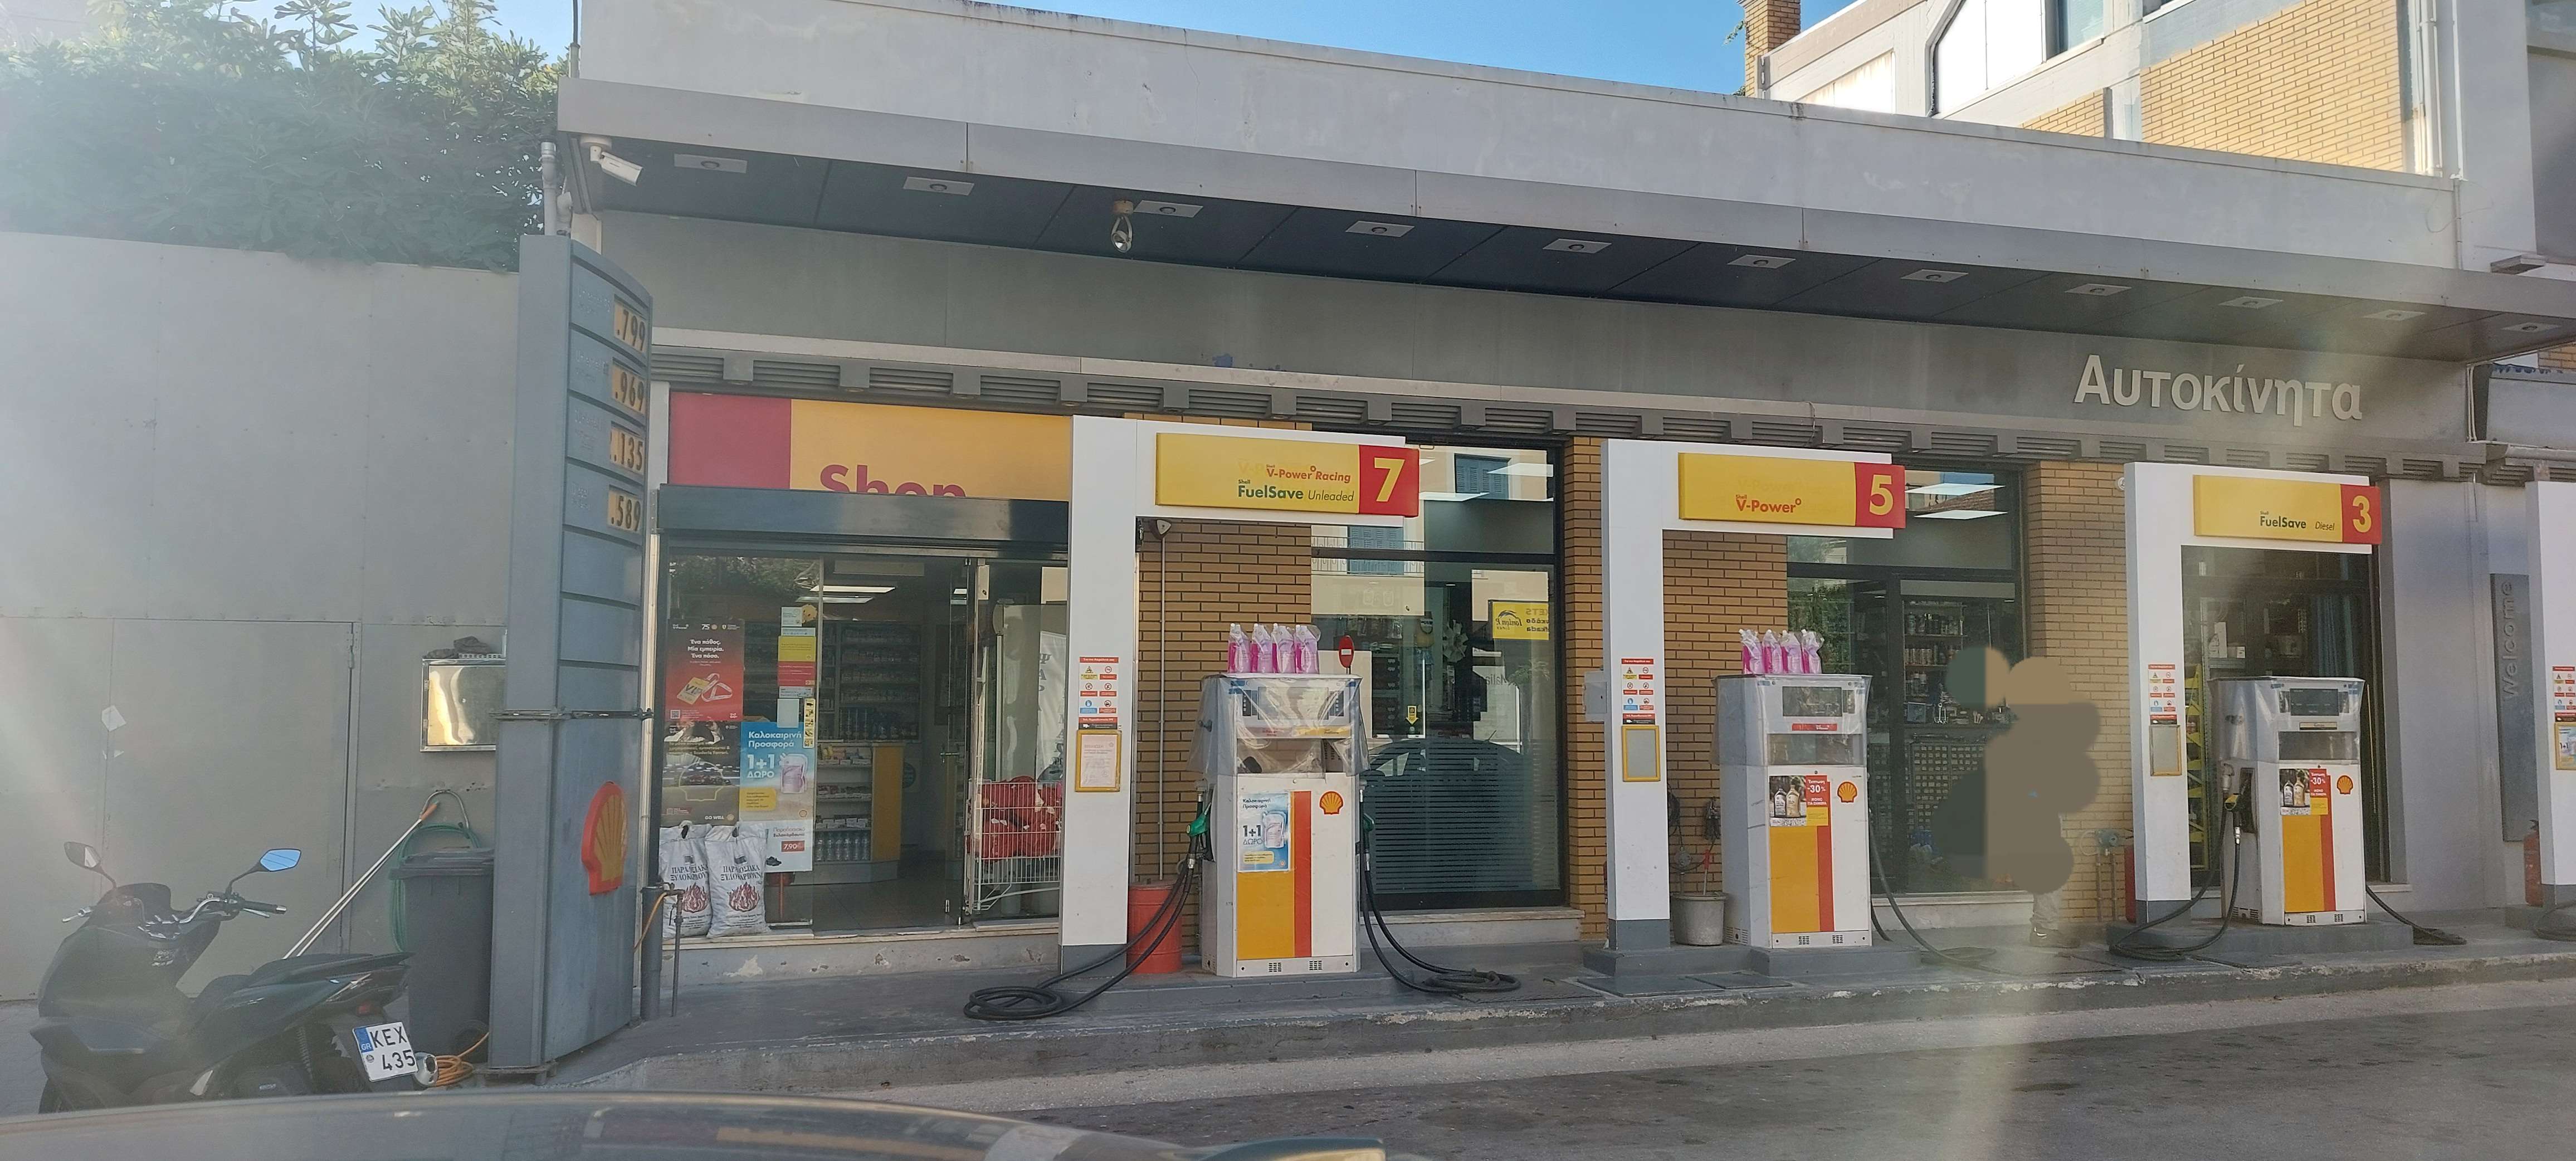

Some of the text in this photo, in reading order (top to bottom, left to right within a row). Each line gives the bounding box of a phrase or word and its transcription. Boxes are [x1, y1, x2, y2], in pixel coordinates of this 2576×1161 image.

[617, 309, 646, 352] .799
[614, 371, 645, 412] .969
[2074, 354, 2363, 427] Αυτοκίνητα
[610, 432, 643, 471] .135
[1266, 468, 1351, 484] V-Power Racing
[1374, 457, 1406, 502] 7
[1237, 485, 1354, 501] FuelSave Unleaded
[1868, 474, 1894, 516] 5
[611, 495, 641, 532] .589
[1736, 500, 1796, 513] V-Power
[2353, 495, 2372, 533] 3
[2260, 516, 2335, 531] FuelSave Diesel
[2501, 581, 2518, 698] Welcome
[748, 731, 802, 741] Καλοκαιρινή
[748, 739, 795, 750] Προσφορά
[747, 754, 775, 769] 1+1
[1243, 825, 1261, 837] 1+1
[370, 1026, 407, 1048] KEX
[382, 1049, 416, 1071] 435
